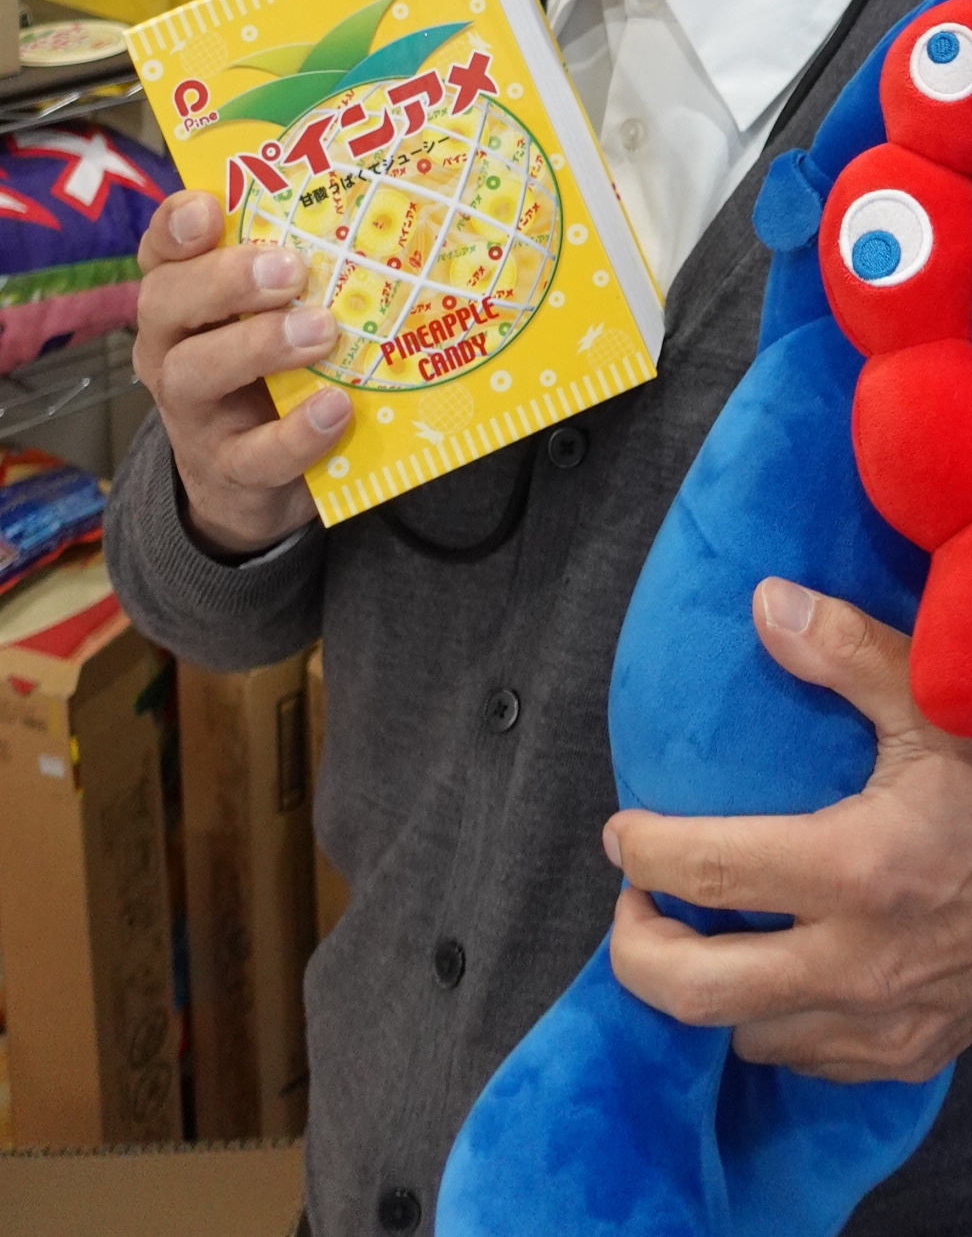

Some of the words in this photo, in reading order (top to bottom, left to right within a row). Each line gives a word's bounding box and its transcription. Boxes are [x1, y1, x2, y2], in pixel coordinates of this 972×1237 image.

[184, 112, 218, 132] Pine
[227, 51, 498, 214] パインアメ
[299, 136, 450, 208] 甘酸っぱくてジューシー
[380, 294, 501, 367] PINEAPPLE
[417, 331, 490, 383] CANDY
